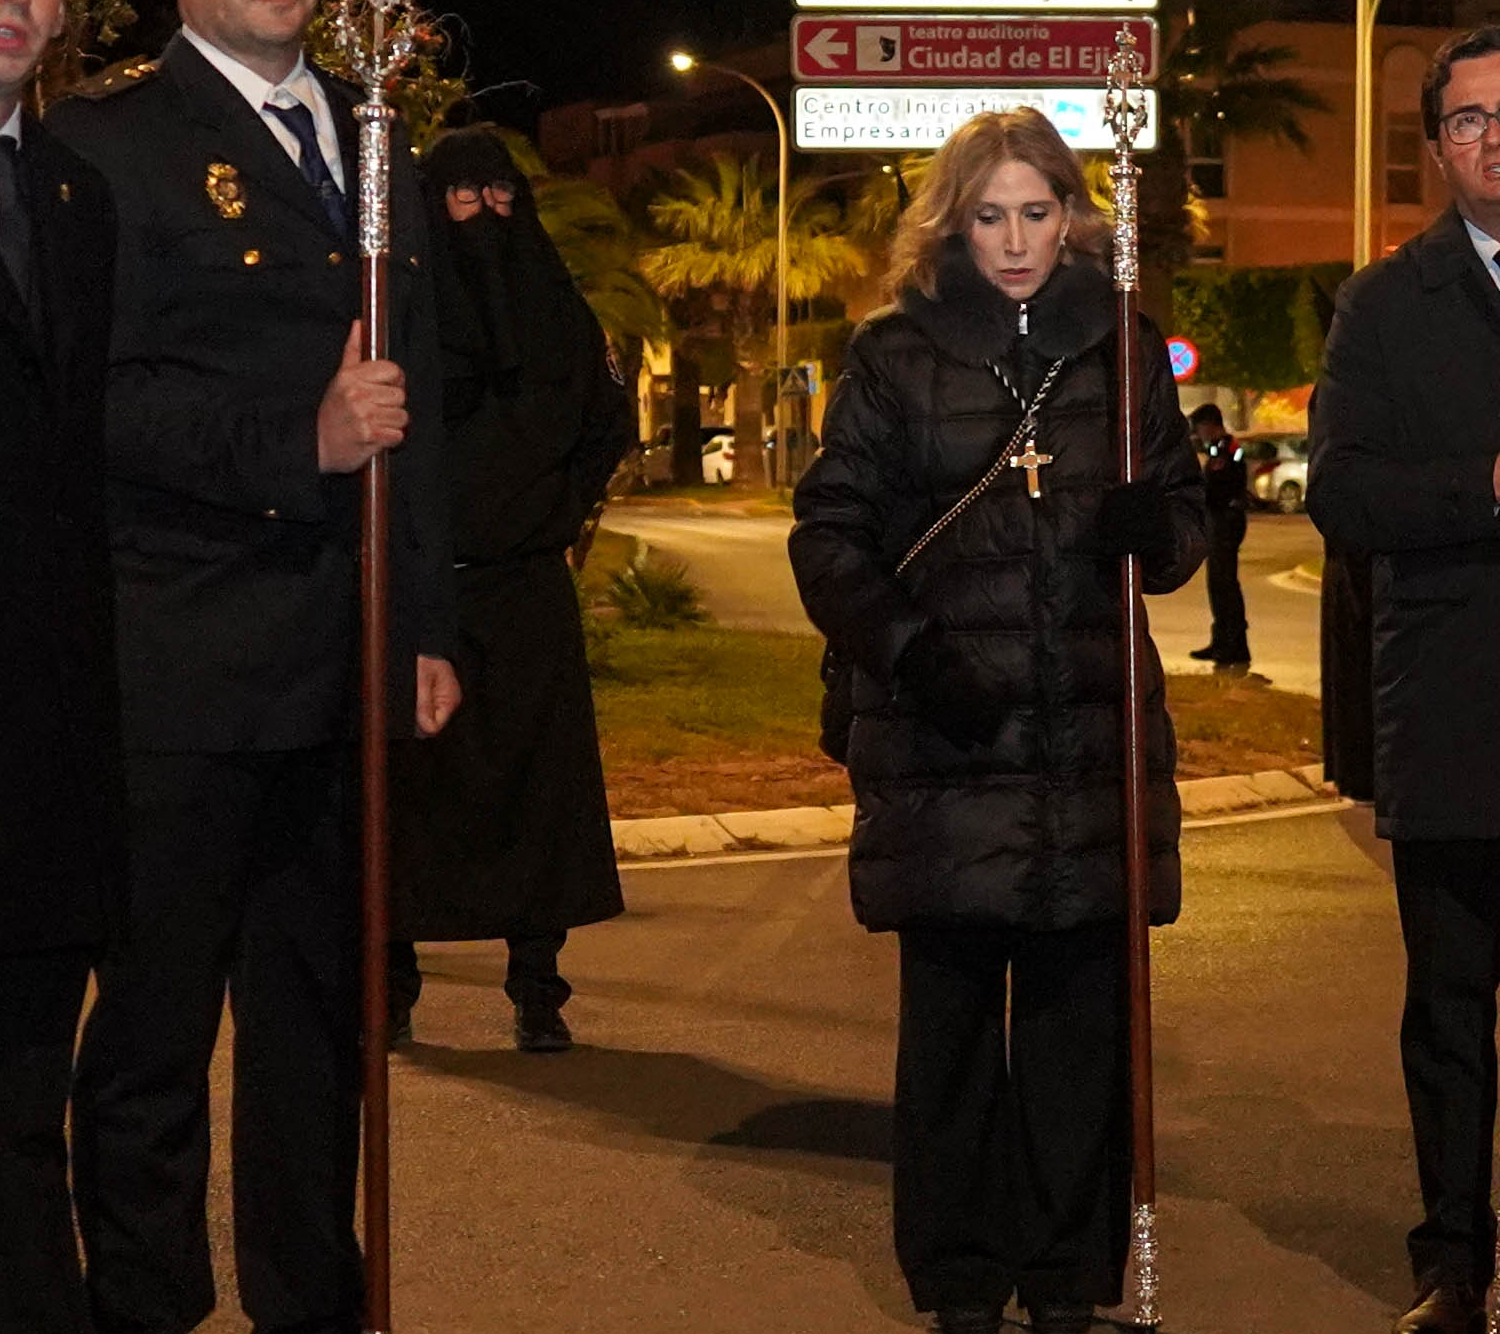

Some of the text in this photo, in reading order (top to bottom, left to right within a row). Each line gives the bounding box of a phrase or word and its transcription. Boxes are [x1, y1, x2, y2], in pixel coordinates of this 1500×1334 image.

[909, 24, 1049, 40] teatro auditorio
[908, 45, 1145, 74] Ciudad de El Ejio
[804, 97, 890, 114] Centro
